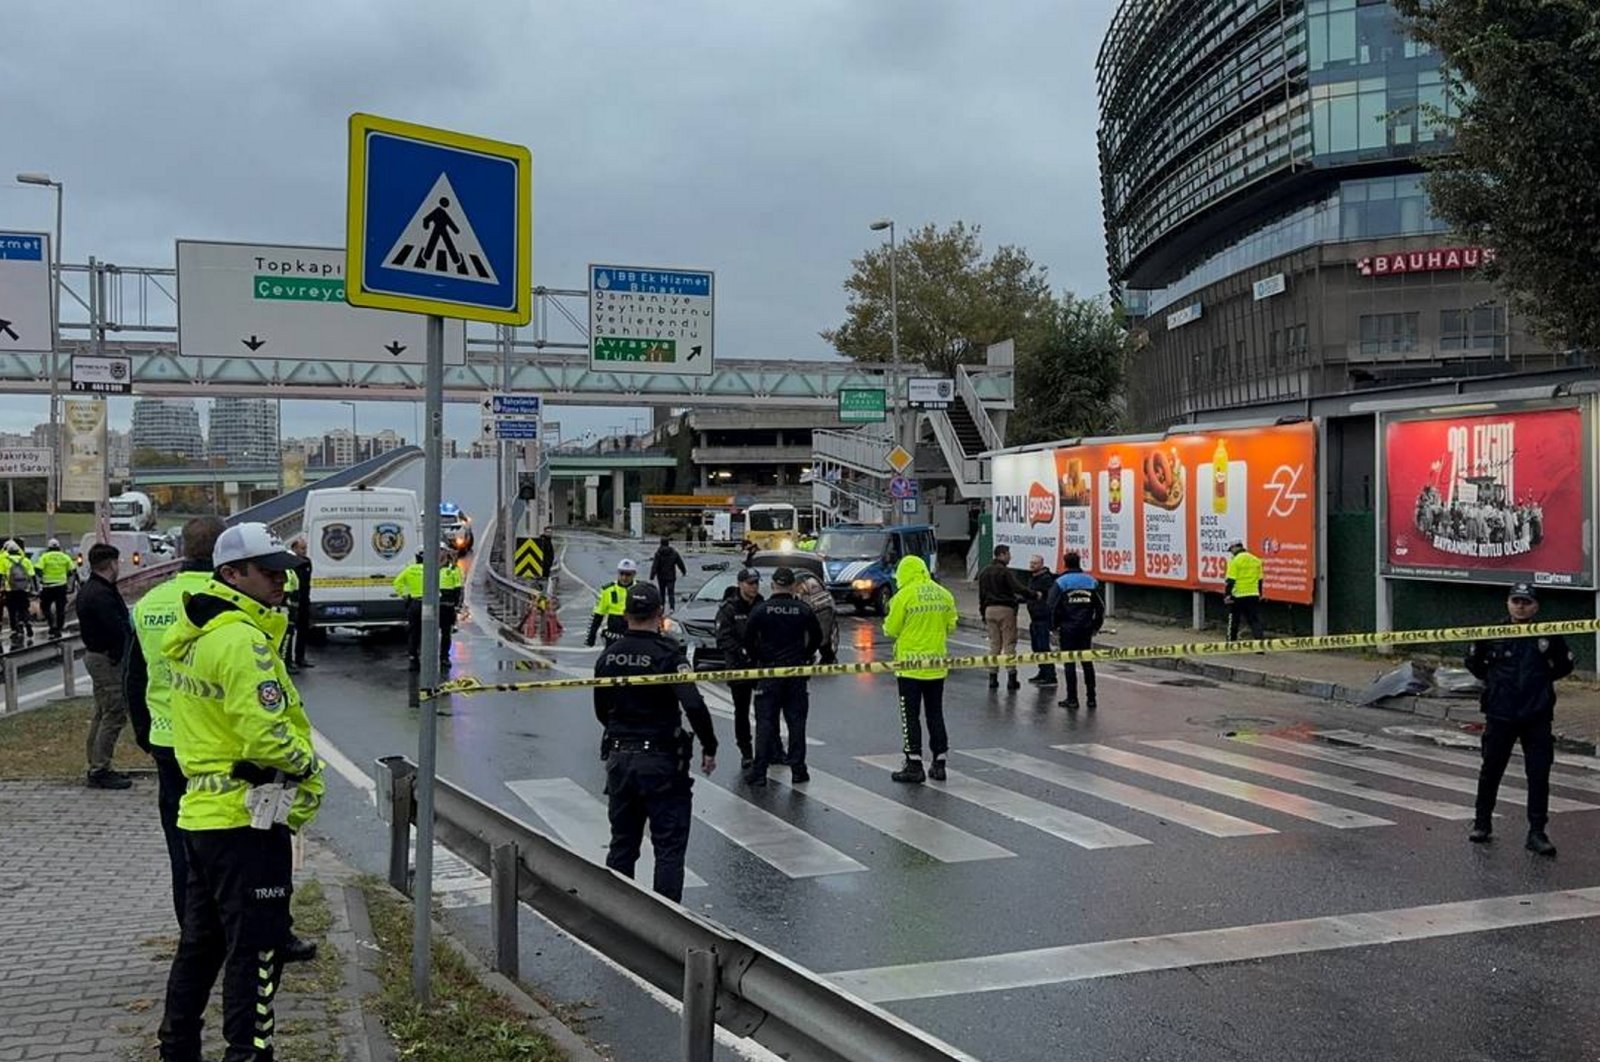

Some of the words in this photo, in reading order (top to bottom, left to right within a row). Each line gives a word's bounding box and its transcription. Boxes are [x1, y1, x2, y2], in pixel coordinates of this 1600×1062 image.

[254, 257, 341, 276] Topkapı
[1376, 248, 1495, 272] BAUHAUS
[660, 275, 707, 287] Hizmet
[596, 291, 691, 305] Osmaniye
[596, 301, 710, 317] Zeytinburnu
[596, 313, 698, 328] Veliefendi
[596, 325, 698, 338] Sahilyolu
[597, 338, 669, 351] Avrasya
[995, 496, 1027, 523] ZIRHLI
[1029, 497, 1055, 520] gross
[1504, 539, 1531, 556] OLSUN
[144, 611, 177, 625] TRAFİ
